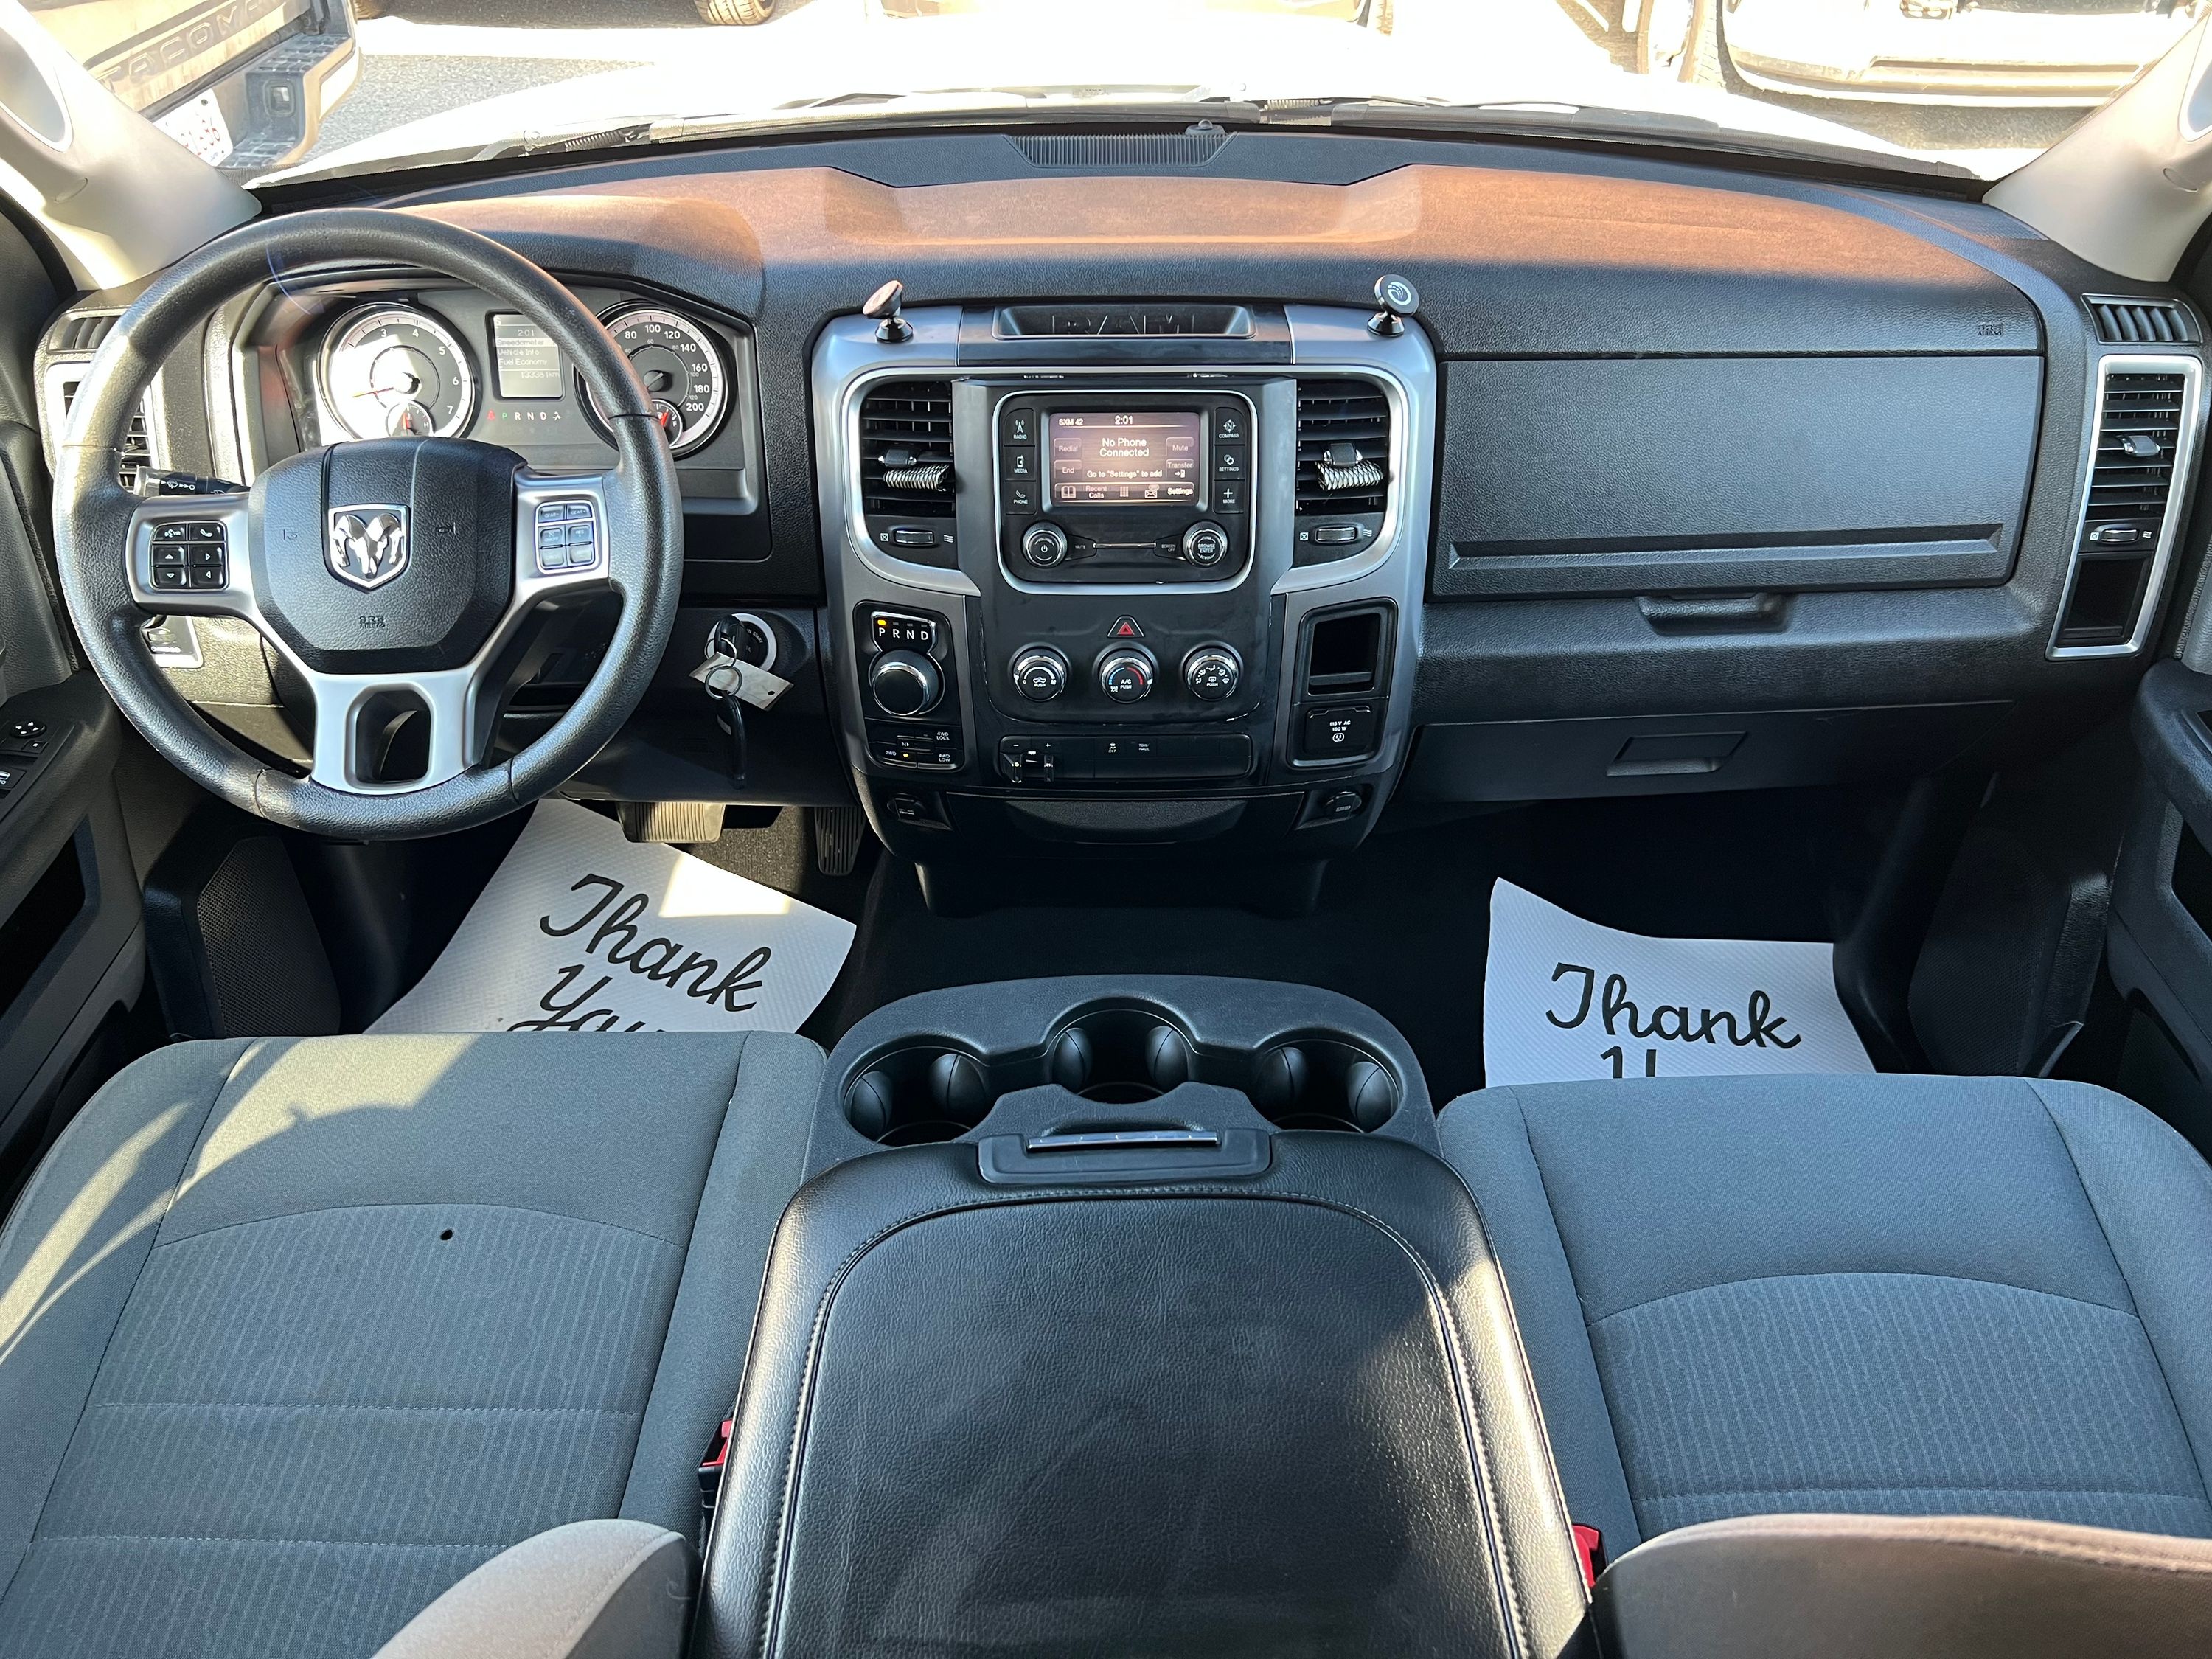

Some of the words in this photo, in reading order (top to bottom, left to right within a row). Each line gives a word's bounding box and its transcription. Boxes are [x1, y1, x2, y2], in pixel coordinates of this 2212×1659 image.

[381, 328, 387, 338] 3
[645, 324, 661, 333] 100
[412, 329, 420, 338] 4
[625, 331, 637, 339] 80
[664, 331, 681, 339] 120
[439, 346, 445, 355] 5
[680, 344, 696, 352] 140
[692, 364, 708, 372] 160
[452, 377, 459, 386] 6
[694, 385, 710, 393] 180
[447, 406, 453, 414] 7
[686, 403, 704, 411] 200
[515, 412, 521, 420] R
[527, 412, 535, 420] N
[540, 412, 547, 420] D
[1114, 415, 1133, 425] 2:01
[1102, 438, 1116, 447] No
[1117, 438, 1147, 447] Phone
[1099, 448, 1150, 457] Connected
[1167, 487, 1194, 495] Settings
[878, 627, 886, 636] P
[892, 628, 900, 639] R
[906, 630, 914, 640] N
[920, 630, 929, 640] D
[540, 873, 771, 1012] Thank
[1545, 961, 1802, 1049] Thank
